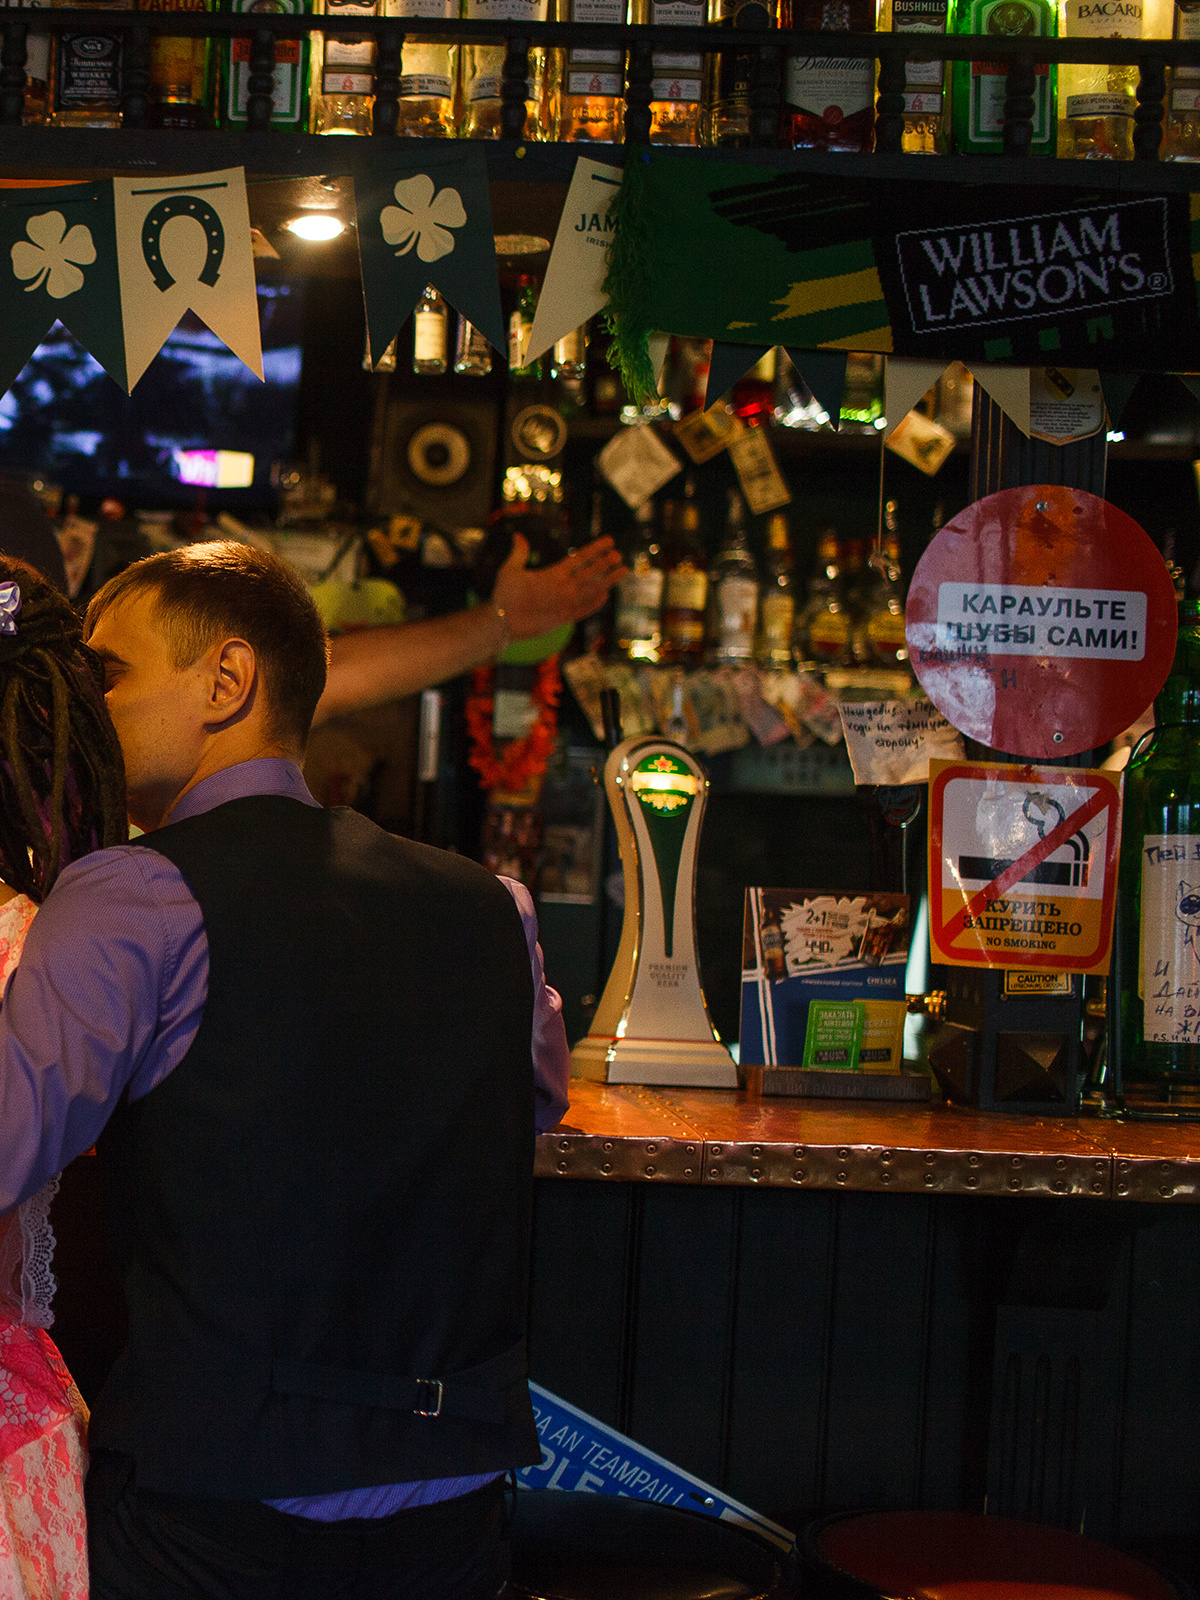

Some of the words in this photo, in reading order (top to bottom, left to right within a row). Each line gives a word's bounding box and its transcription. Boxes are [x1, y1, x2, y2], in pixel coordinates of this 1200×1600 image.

[894, 1, 947, 13] BUSHMILLS
[919, 213, 1122, 278] WILLIAM
[918, 252, 1146, 322] LAWSON'S
[962, 593, 1127, 621] КАРАУЛЬТЕ
[1047, 625, 1138, 650] САМИ!
[806, 908, 827, 926] 2+1
[985, 899, 1061, 917] КУРИТЬ
[963, 916, 1083, 937] ЗАПРЕЩЕНО
[986, 937, 1002, 946] NO
[1003, 938, 1057, 950] SMOKING
[866, 976, 897, 986] CHELSEA
[1017, 974, 1058, 983] CAUTION
[548, 1425, 585, 1453] AN
